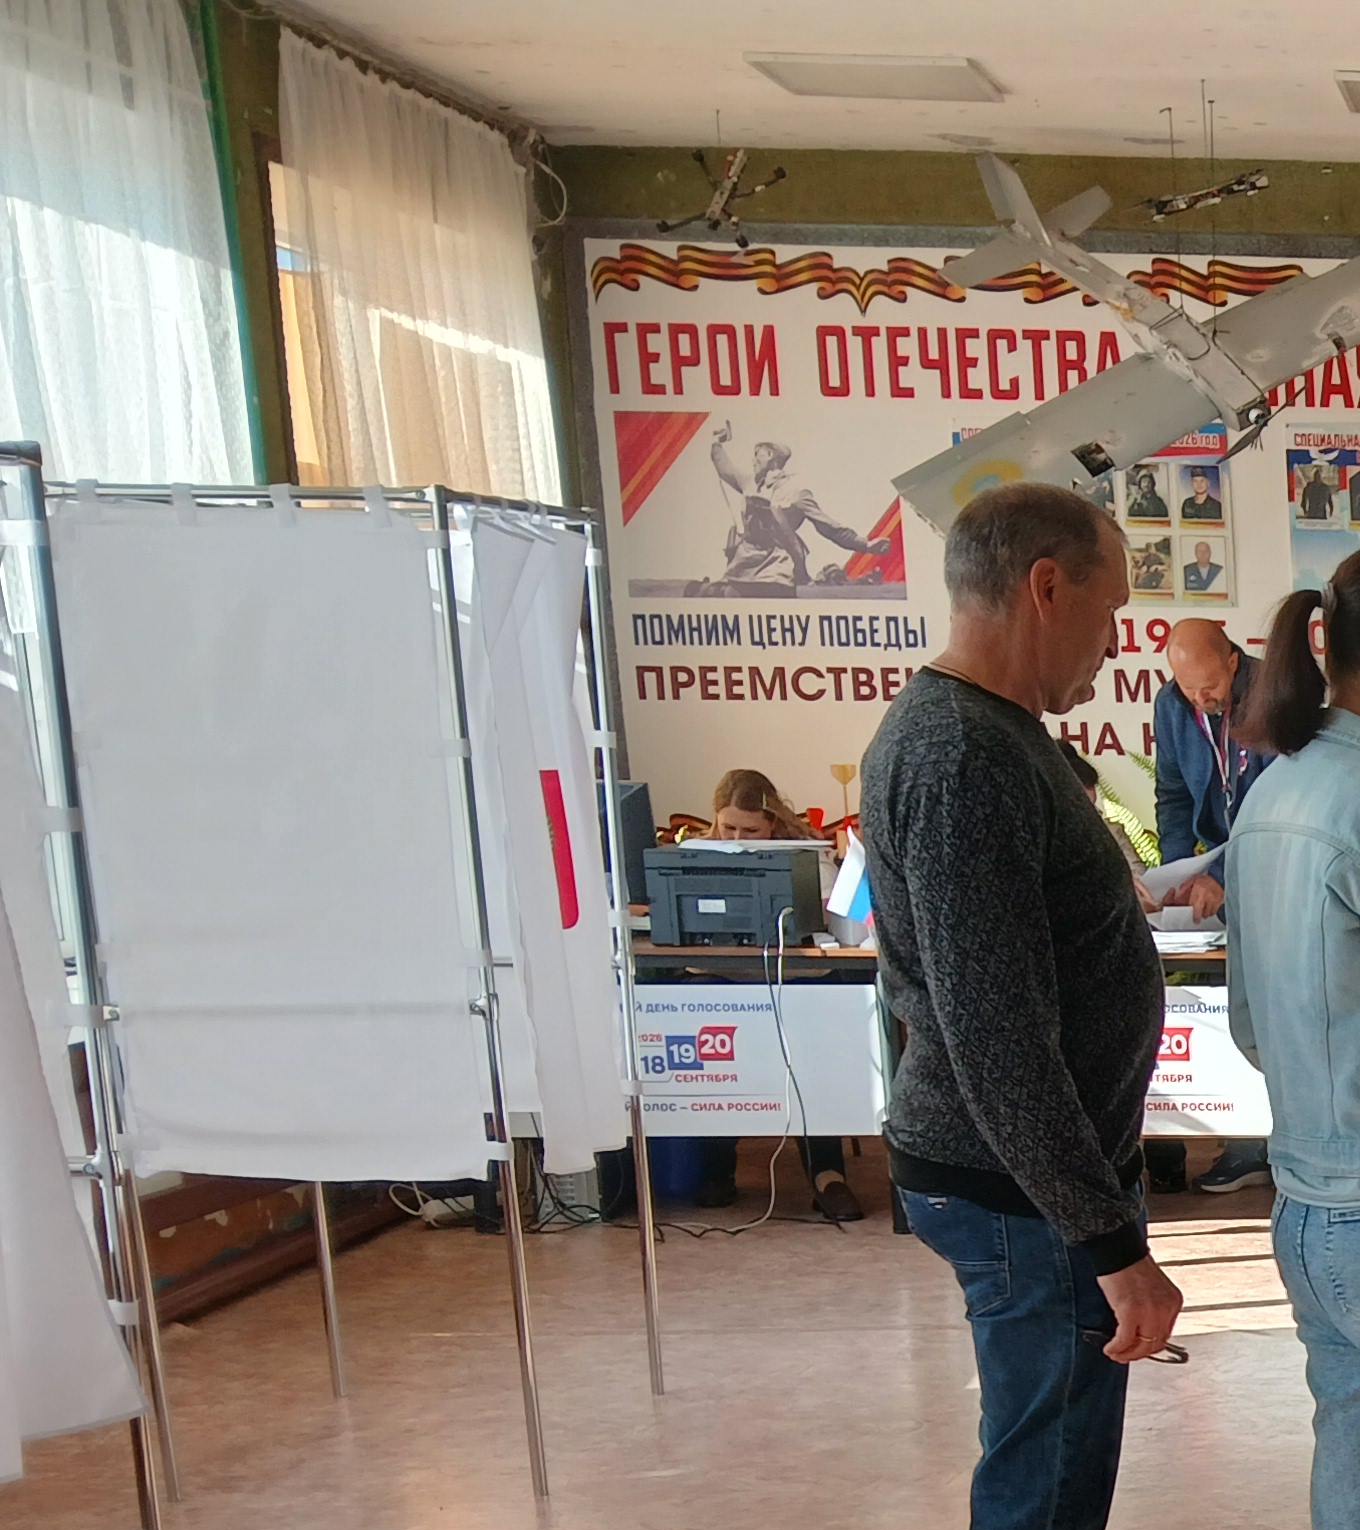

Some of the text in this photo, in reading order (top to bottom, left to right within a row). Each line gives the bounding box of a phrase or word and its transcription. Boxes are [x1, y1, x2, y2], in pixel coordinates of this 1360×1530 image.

[602, 321, 780, 397] ГЕРОИ
[632, 613, 928, 652] ПОМНИМ ЦЕНУ ПОБЕДЫ
[635, 665, 913, 702] ПРЕЕМСТВЕ
[646, 1003, 678, 1013] ДЕНЬ
[681, 1003, 773, 1013] ГОЛОСОВАНИЯ
[669, 1043, 696, 1064] 19
[700, 1033, 732, 1055] 20
[1158, 1034, 1188, 1055] 20
[640, 1055, 666, 1075] 18
[674, 1073, 738, 1083] СЕНТЯБРЯ
[643, 1102, 677, 1112] ОЛОС
[690, 1102, 724, 1112] СИЛА
[727, 1102, 782, 1112] РОССИИ!
[1146, 1102, 1235, 1112] СИЛА РОССИИ!
